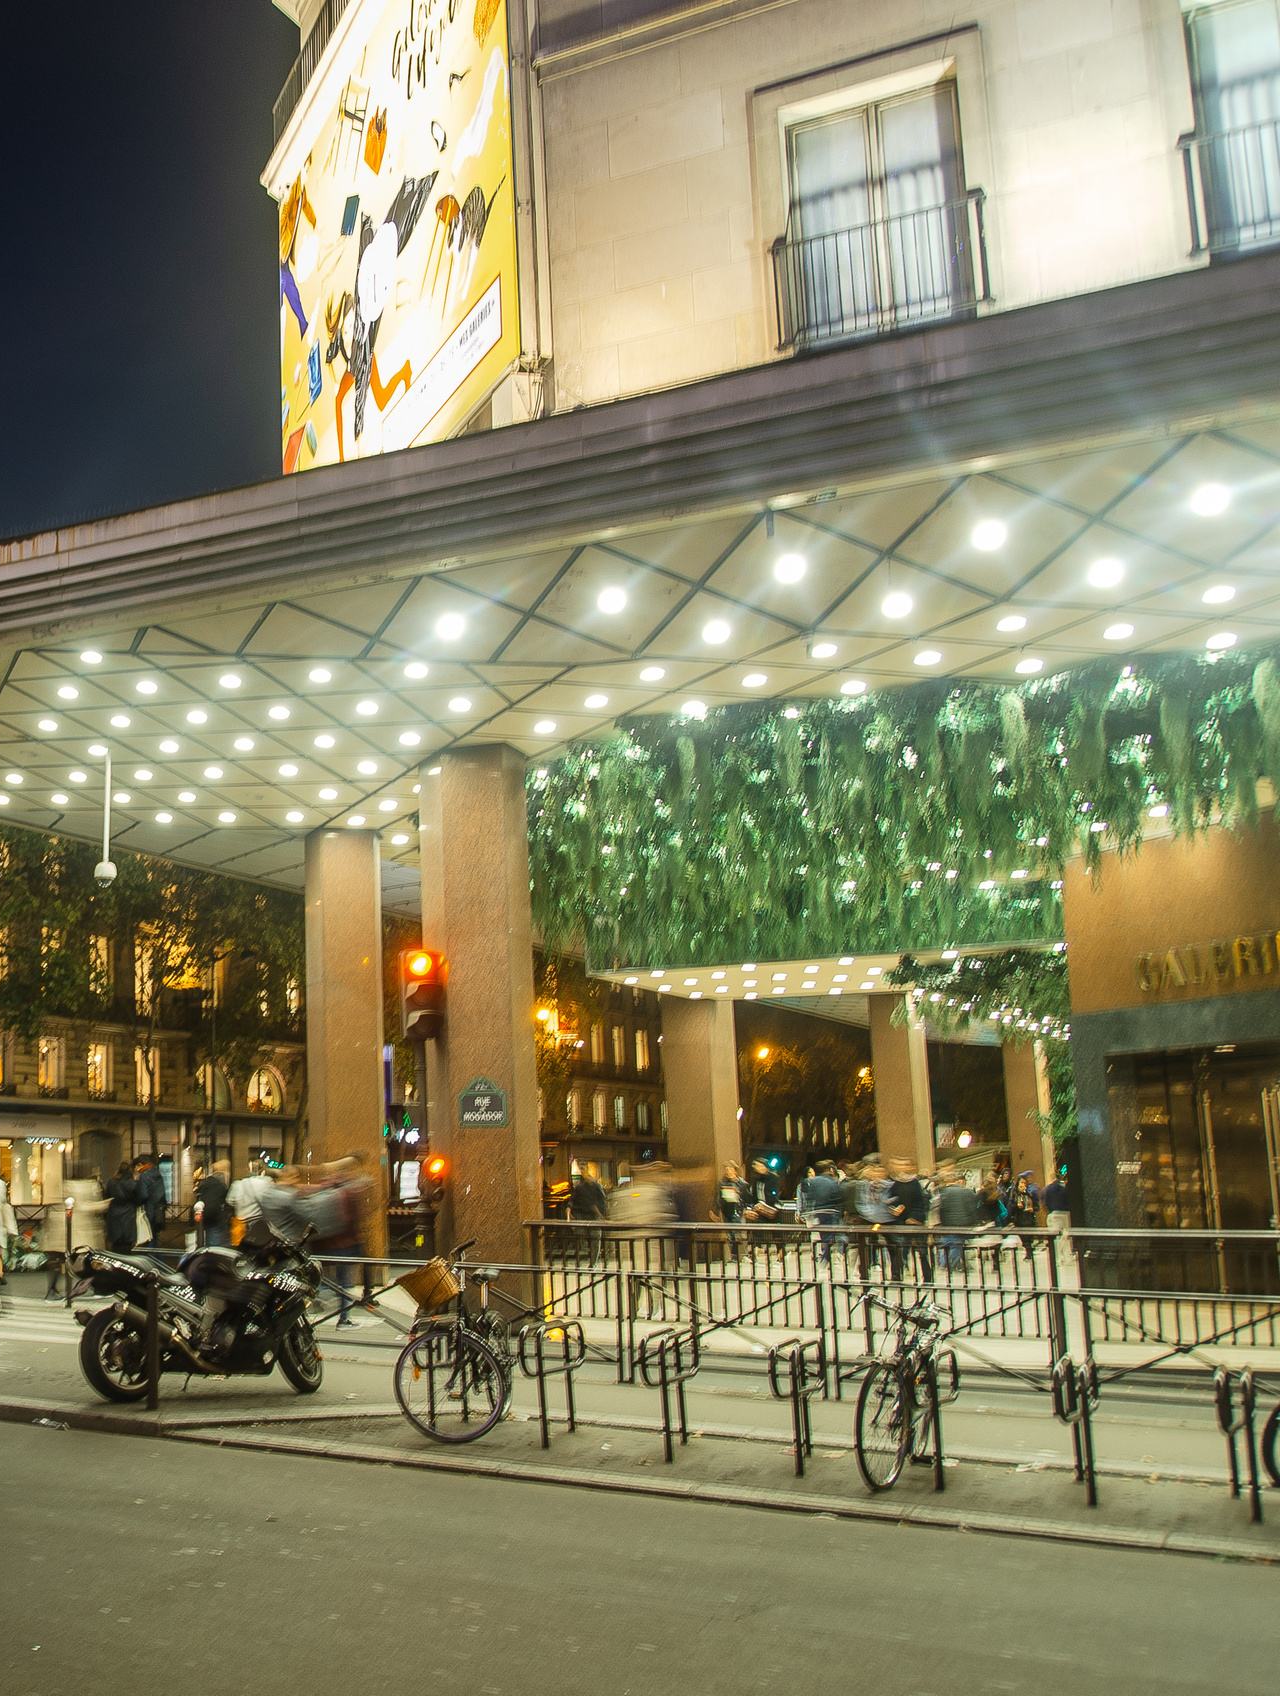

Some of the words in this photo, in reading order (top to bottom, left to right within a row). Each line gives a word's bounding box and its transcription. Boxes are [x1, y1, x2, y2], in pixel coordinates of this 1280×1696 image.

[1135, 929, 1280, 991] GALERI
[474, 1096, 491, 1107] RUE
[463, 1111, 503, 1122] MOGADOR
